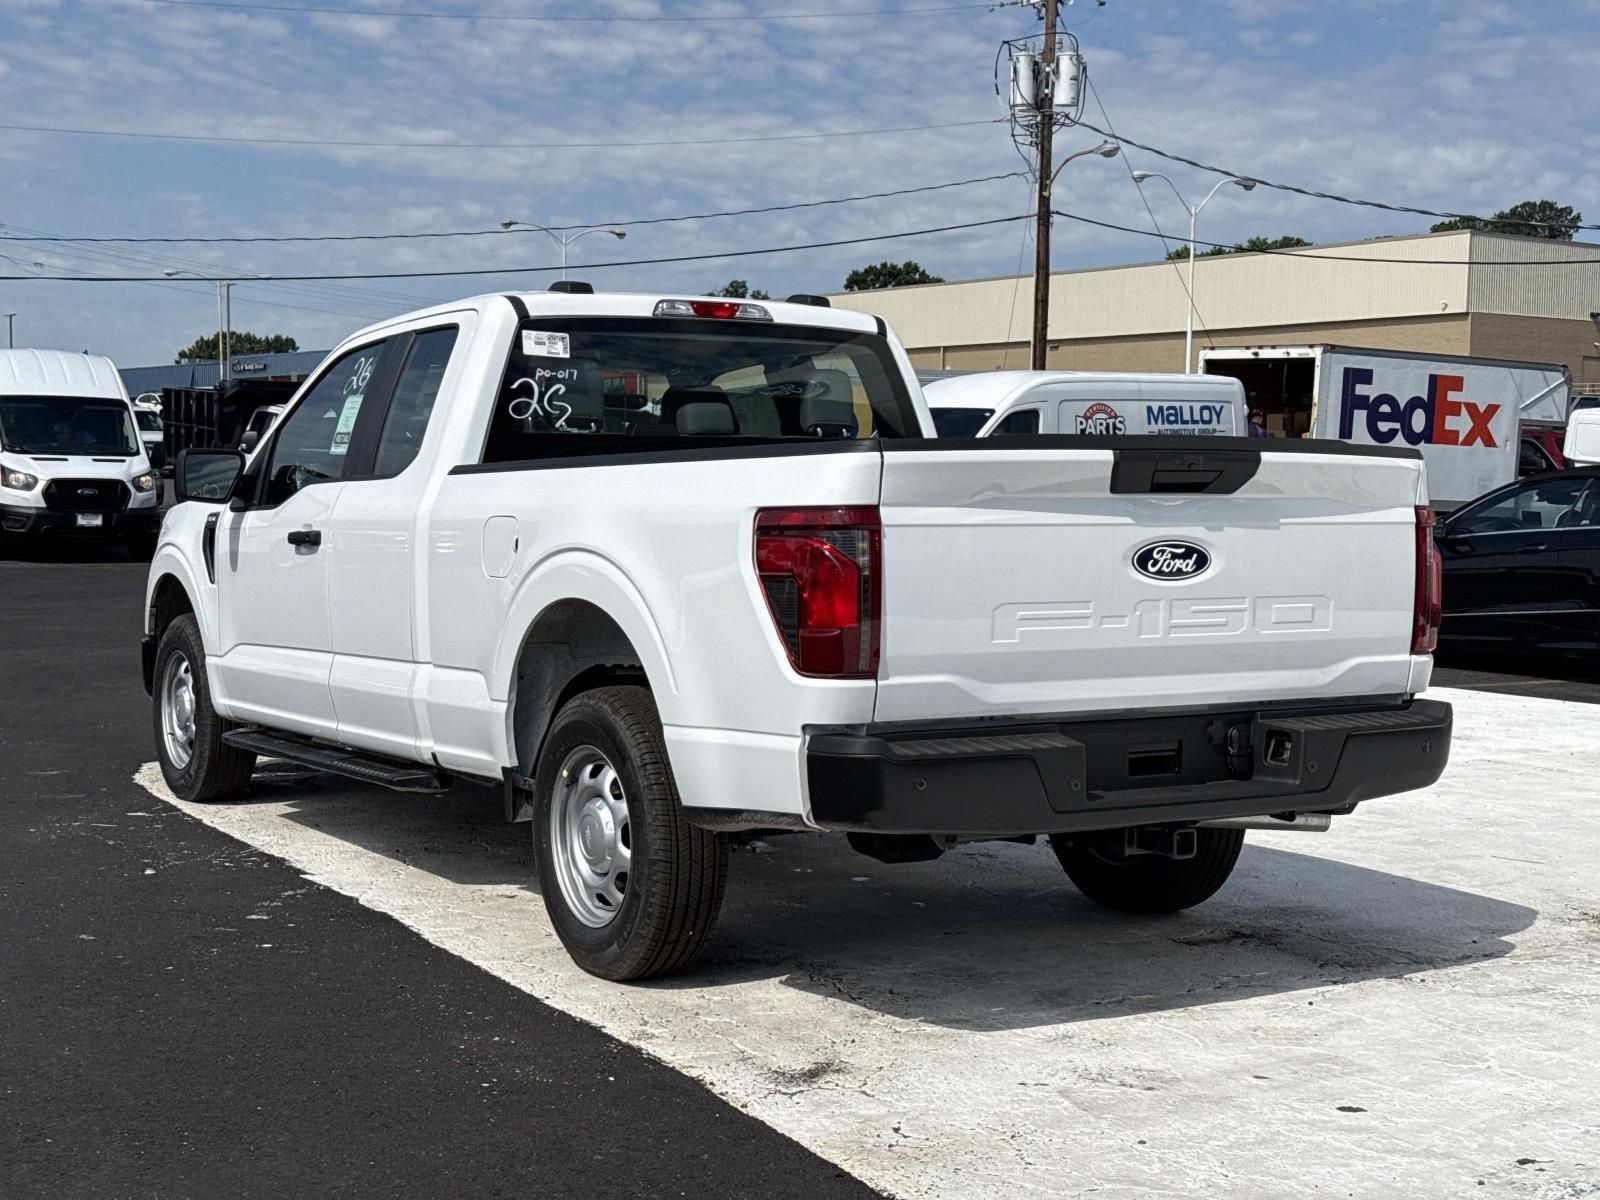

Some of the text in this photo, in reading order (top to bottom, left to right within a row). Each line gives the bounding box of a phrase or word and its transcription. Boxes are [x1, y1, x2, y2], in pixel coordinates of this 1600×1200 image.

[1338, 366, 1501, 448] FedEx
[1075, 415, 1126, 436] PARTS
[1157, 427, 1218, 436] AUTOMOTIVE GROUP
[1147, 546, 1197, 574] Ford
[991, 594, 1334, 644] F-150
